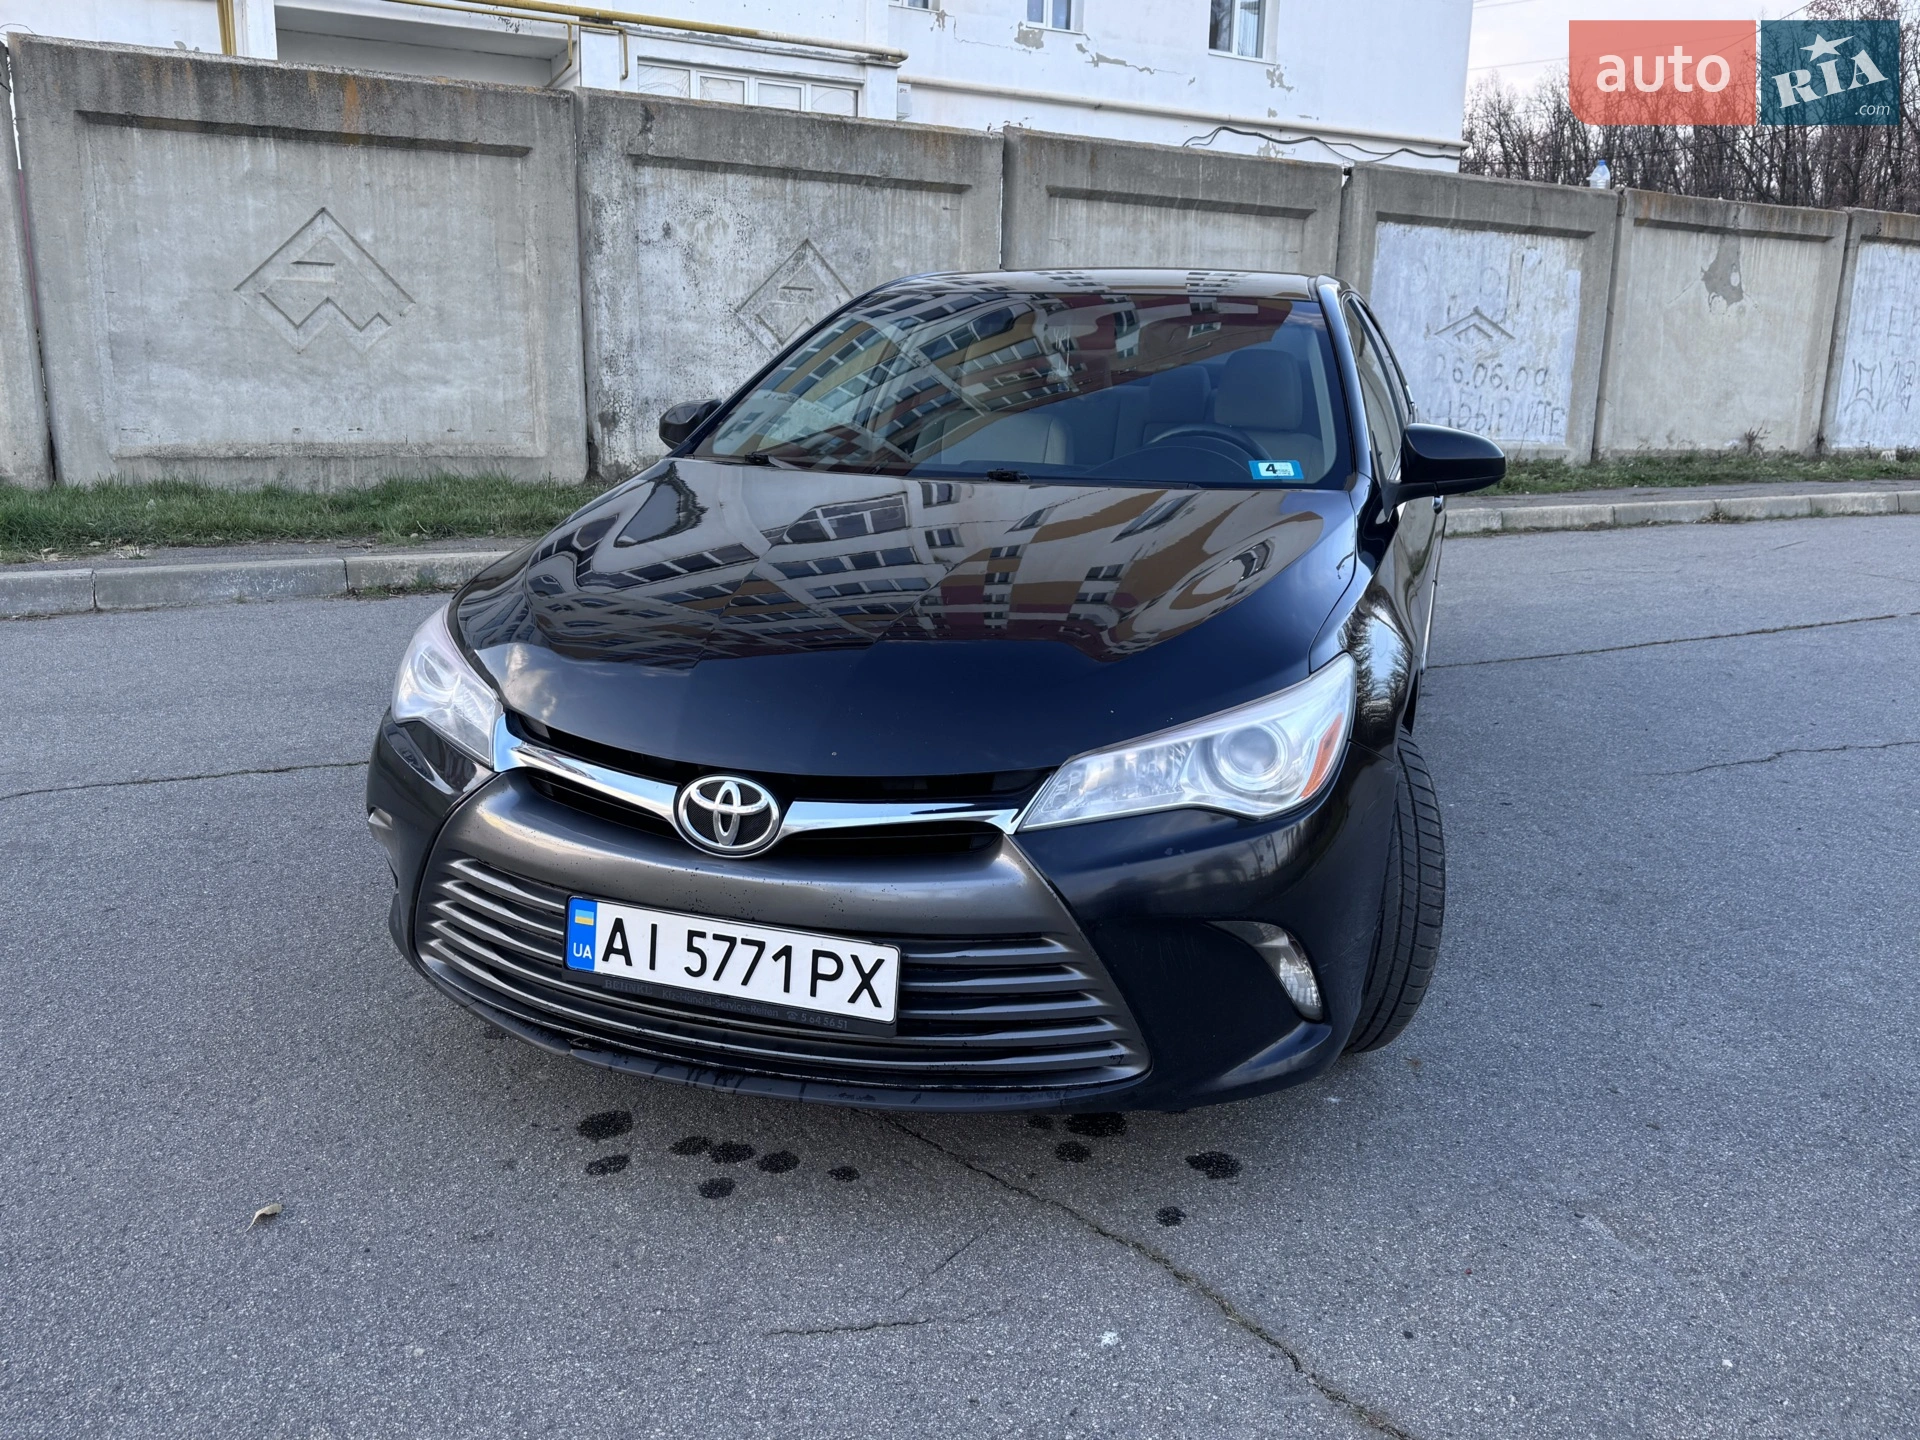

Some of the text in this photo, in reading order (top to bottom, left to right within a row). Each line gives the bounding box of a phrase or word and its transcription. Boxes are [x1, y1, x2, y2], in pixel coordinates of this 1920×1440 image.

[1265, 464, 1277, 474] 4
[573, 943, 593, 960] UA
[602, 917, 886, 1008] AI 5771 PX
